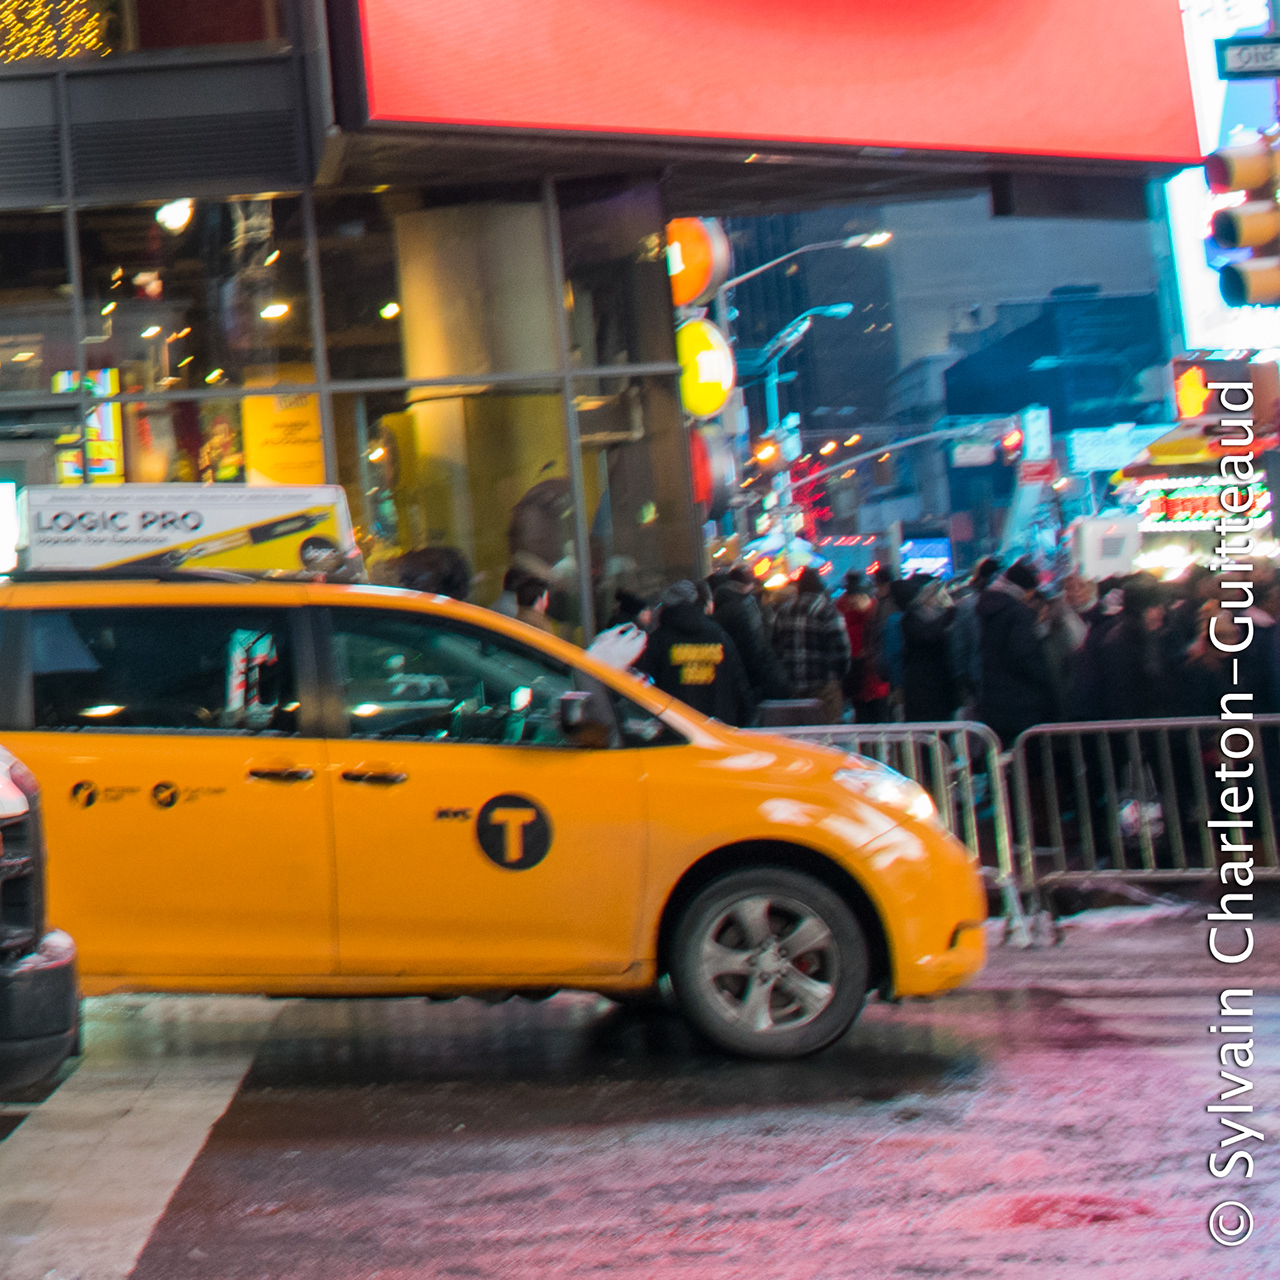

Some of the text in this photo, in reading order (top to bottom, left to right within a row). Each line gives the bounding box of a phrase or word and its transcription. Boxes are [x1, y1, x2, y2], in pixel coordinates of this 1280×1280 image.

[35, 510, 204, 532] LOGIC PRO
[488, 806, 538, 864] T
